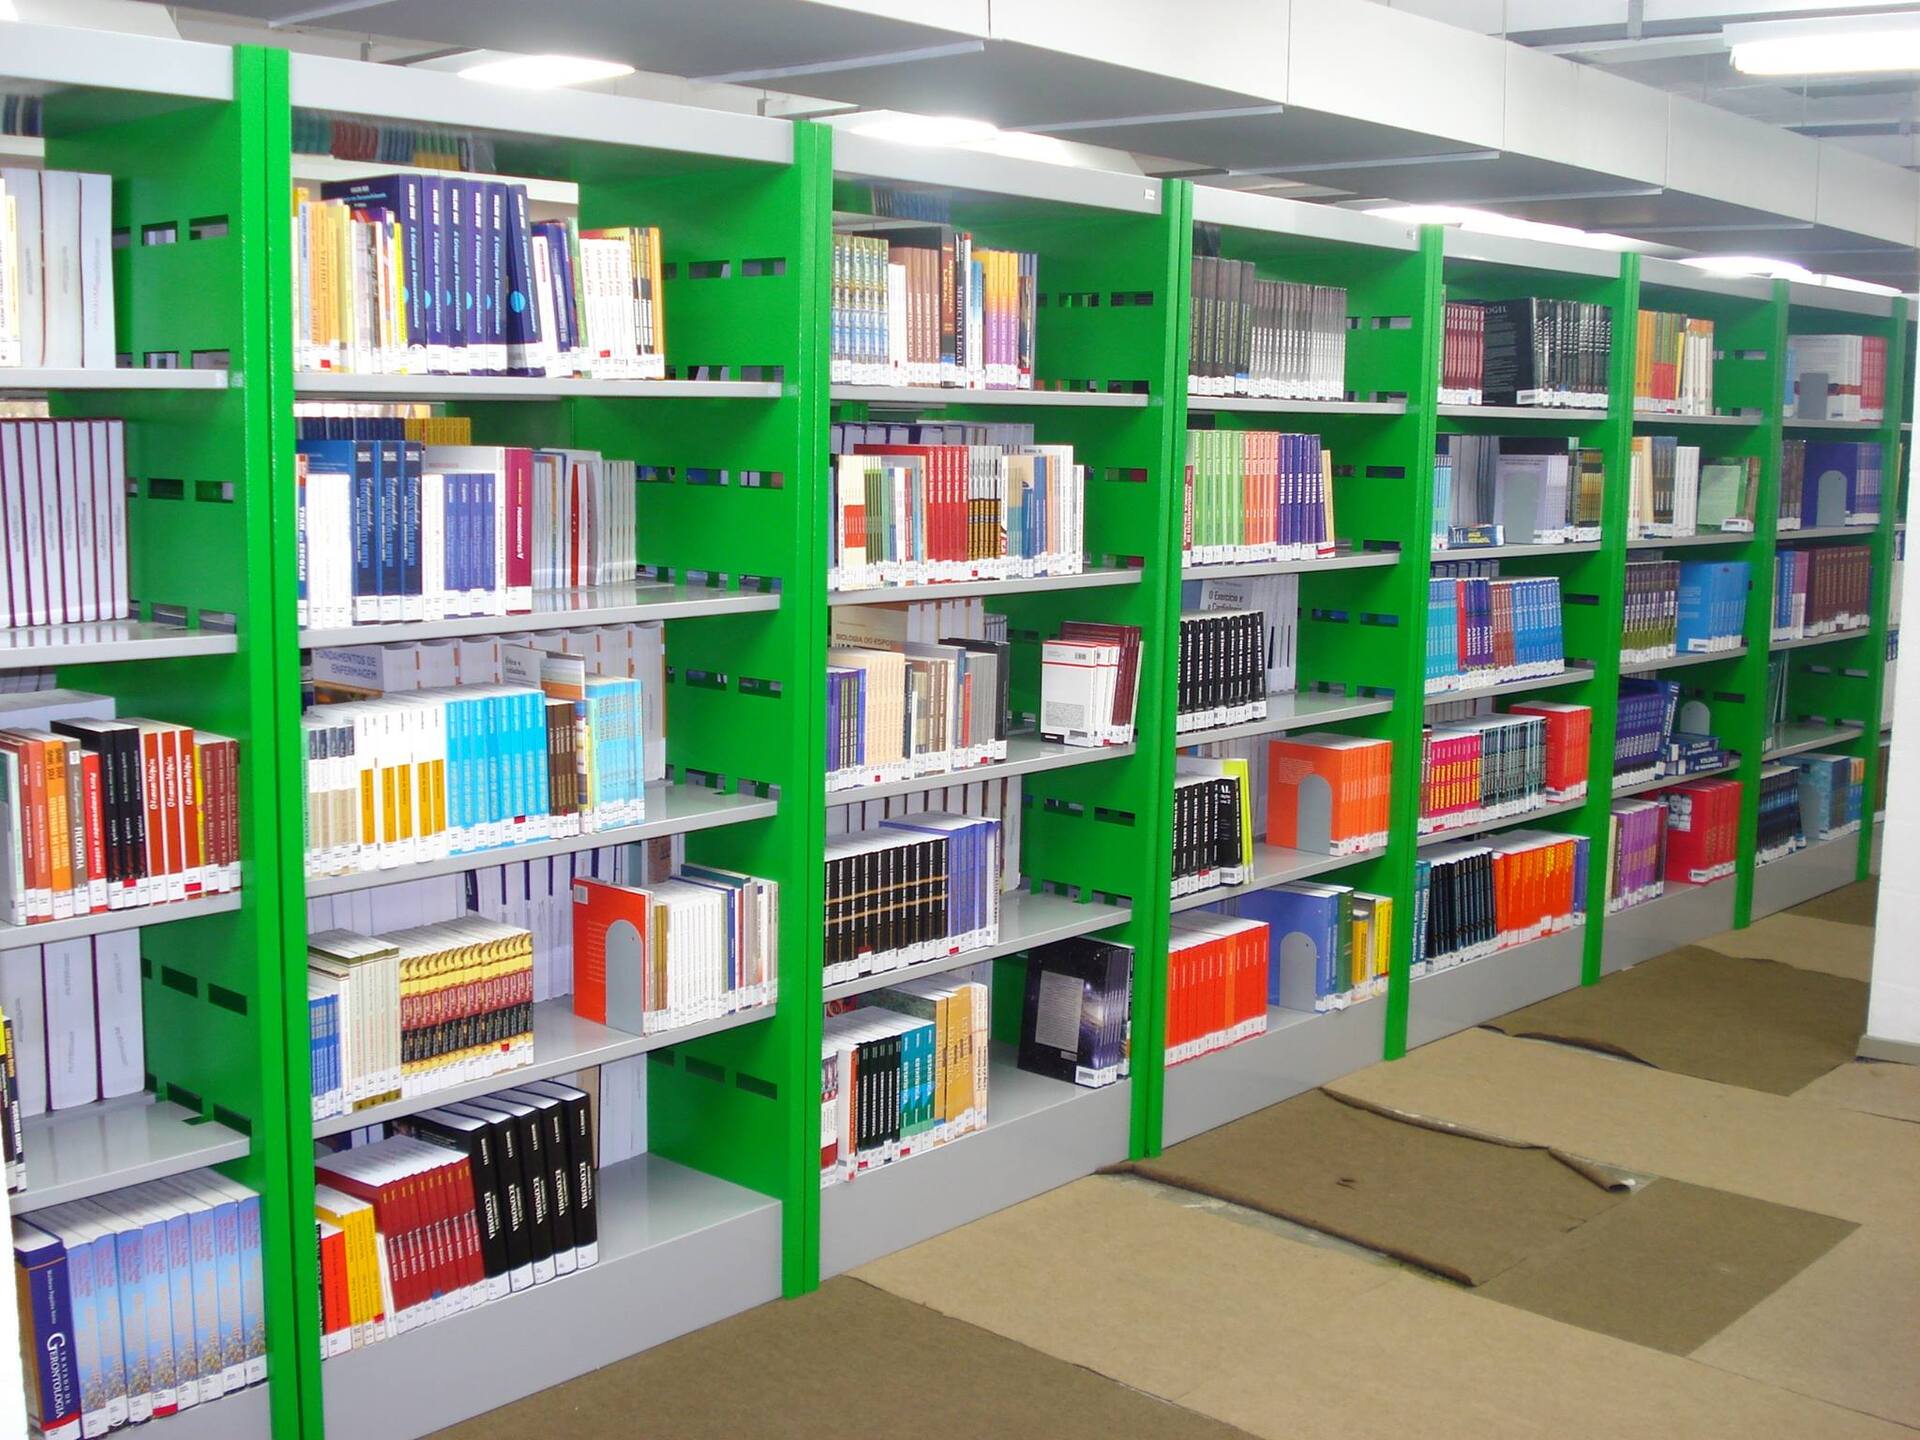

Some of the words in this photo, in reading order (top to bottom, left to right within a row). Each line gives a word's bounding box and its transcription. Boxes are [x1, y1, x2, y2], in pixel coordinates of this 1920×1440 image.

[298, 543, 306, 581] ESCOLAS
[1209, 591, 1213, 599] O
[315, 648, 365, 666] FUNDAMENTOS
[366, 656, 376, 666] DE
[836, 633, 863, 642] BIOLOGIA
[331, 665, 377, 679] ENFERMAGEM
[74, 827, 84, 870] FILOSOFIA
[508, 1184, 519, 1232] ECONOMIA
[532, 1177, 543, 1224] ECONOMIA
[554, 1169, 566, 1216] ECONOMIA
[579, 1162, 588, 1209] ECONOMIA
[484, 1192, 496, 1239] ECONOMIA
[46, 1332, 65, 1419] GERONTOLOGIA
